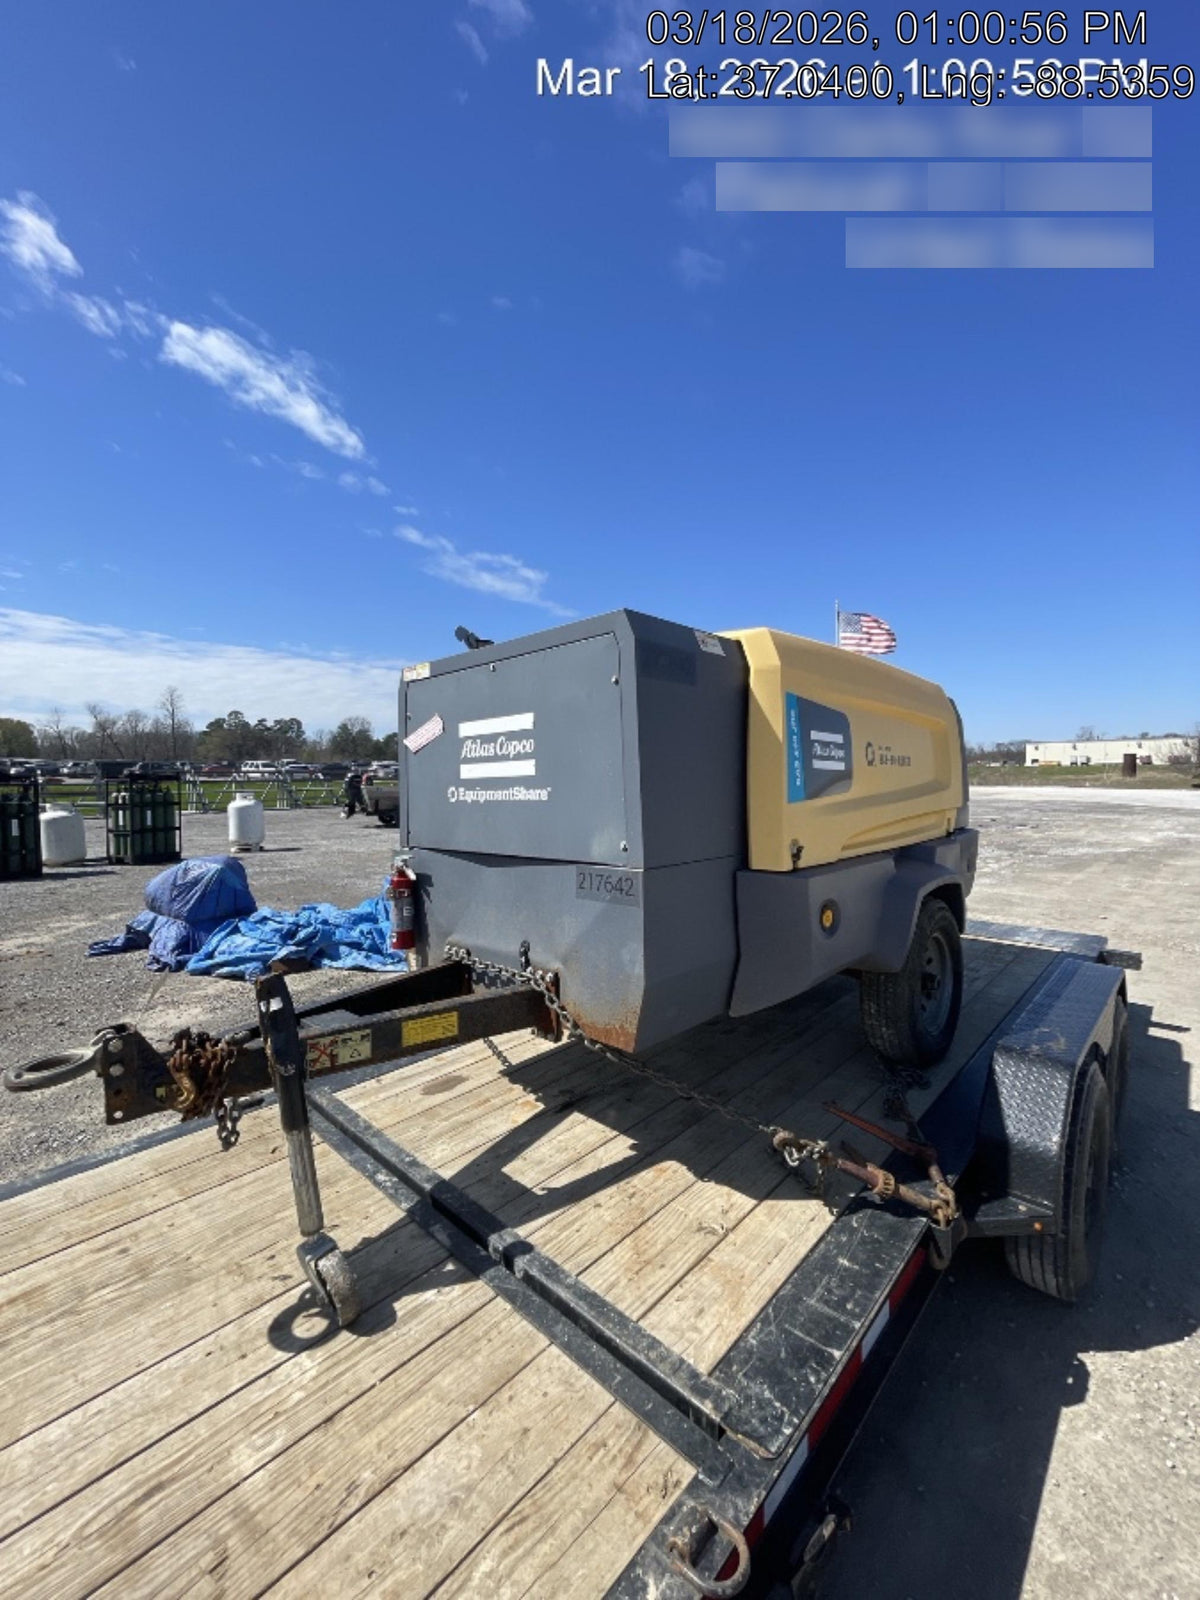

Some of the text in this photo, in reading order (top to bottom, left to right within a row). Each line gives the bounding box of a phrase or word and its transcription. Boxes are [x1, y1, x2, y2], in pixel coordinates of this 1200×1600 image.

[460, 736, 534, 759] Atlas Copco
[458, 786, 548, 804] EquipmentShare
[578, 872, 635, 897] 217642
